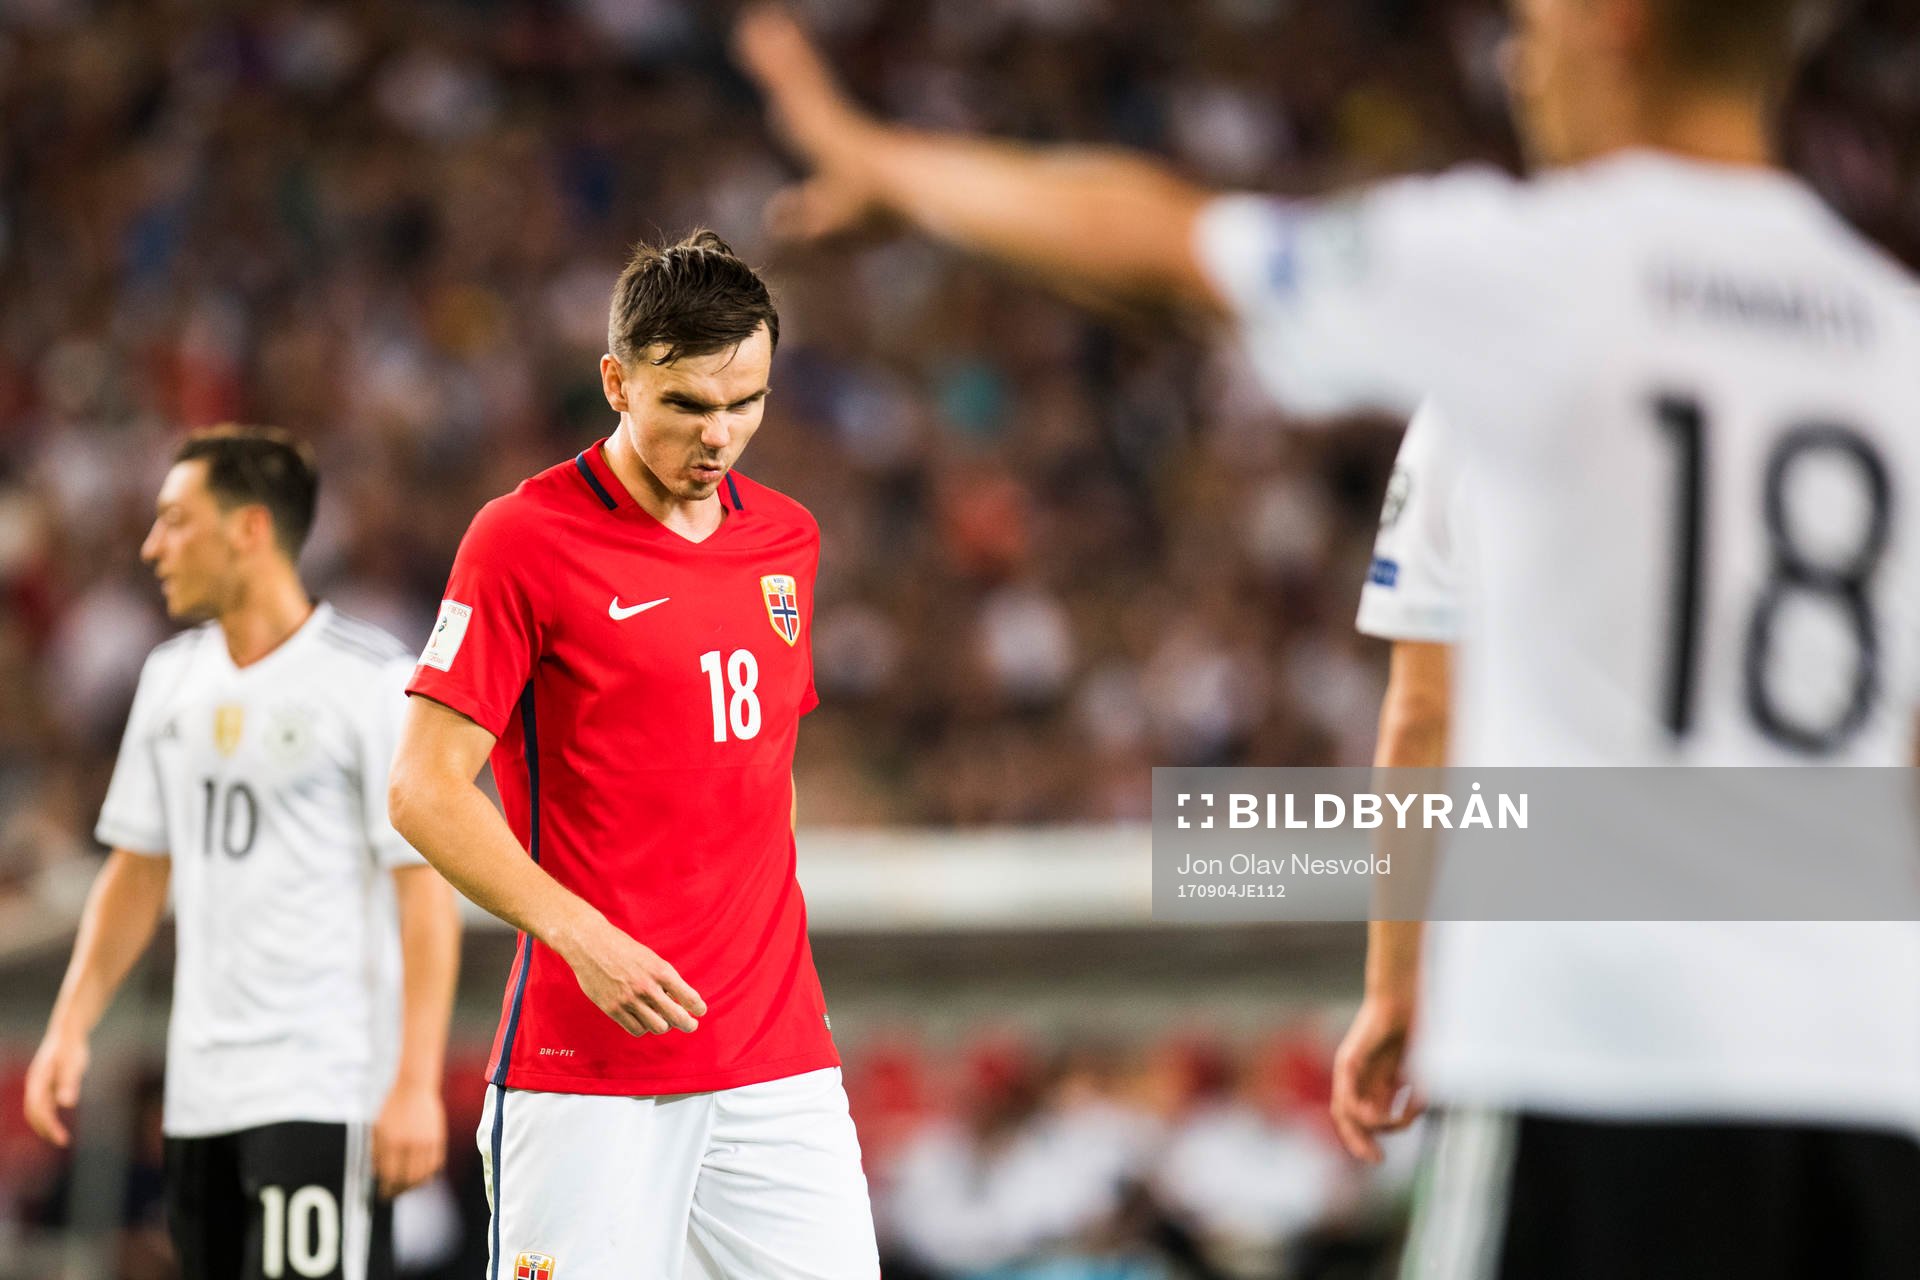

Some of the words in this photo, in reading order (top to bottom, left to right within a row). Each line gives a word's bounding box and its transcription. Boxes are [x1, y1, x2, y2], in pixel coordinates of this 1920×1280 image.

[1646, 391, 1893, 753] 18
[700, 648, 761, 742] 18
[202, 779, 257, 859] 10
[539, 1047, 575, 1057] DRI-FIT
[260, 1185, 339, 1278] 10
